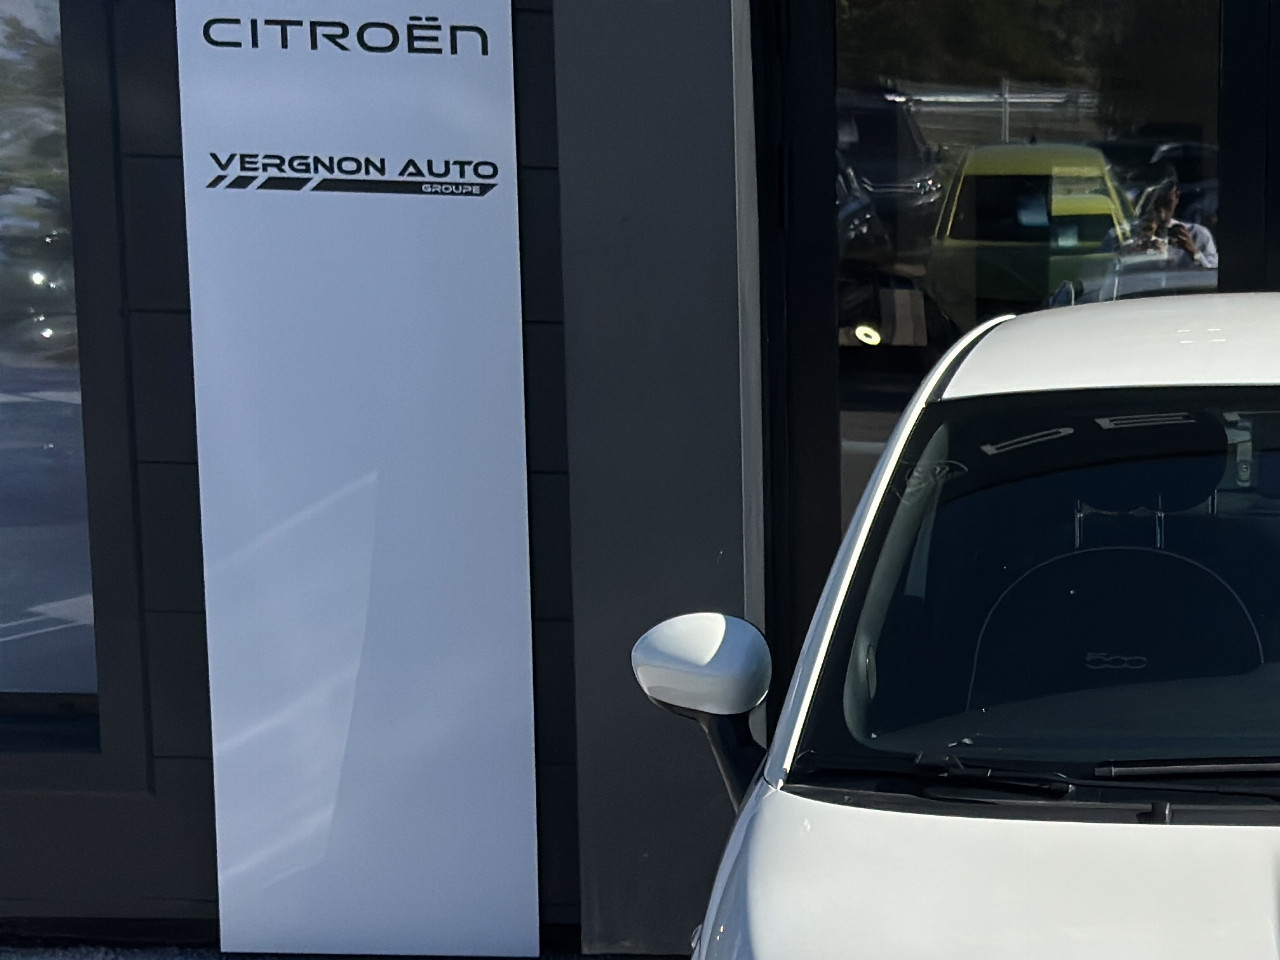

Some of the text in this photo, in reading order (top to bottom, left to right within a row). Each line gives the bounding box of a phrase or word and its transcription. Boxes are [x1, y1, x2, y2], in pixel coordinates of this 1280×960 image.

[210, 153, 498, 179] VERGNON AUTO
[421, 183, 482, 196] GROUPE
